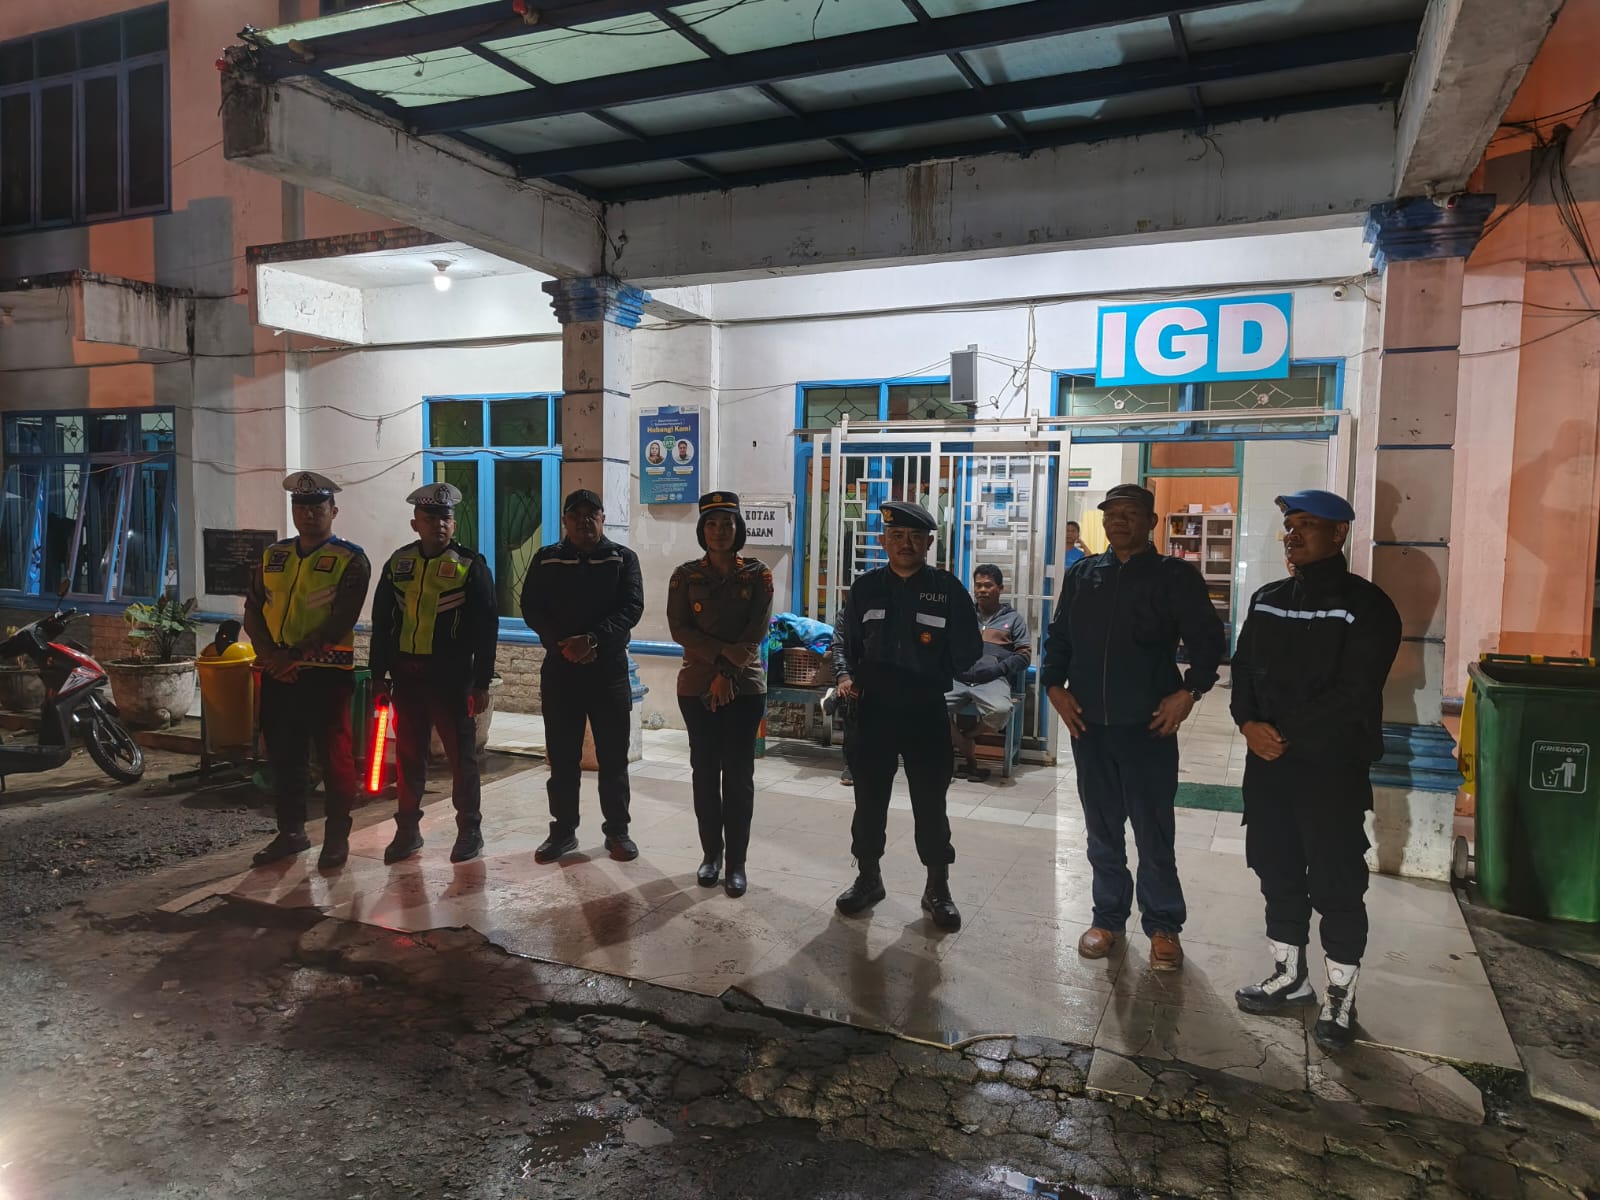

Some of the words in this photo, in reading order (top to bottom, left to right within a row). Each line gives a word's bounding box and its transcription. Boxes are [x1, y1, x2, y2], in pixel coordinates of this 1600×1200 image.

[1101, 302, 1288, 379] IGD
[745, 511, 775, 521] KOTAK
[746, 528, 774, 537] SARAN
[920, 592, 948, 604] POLRI
